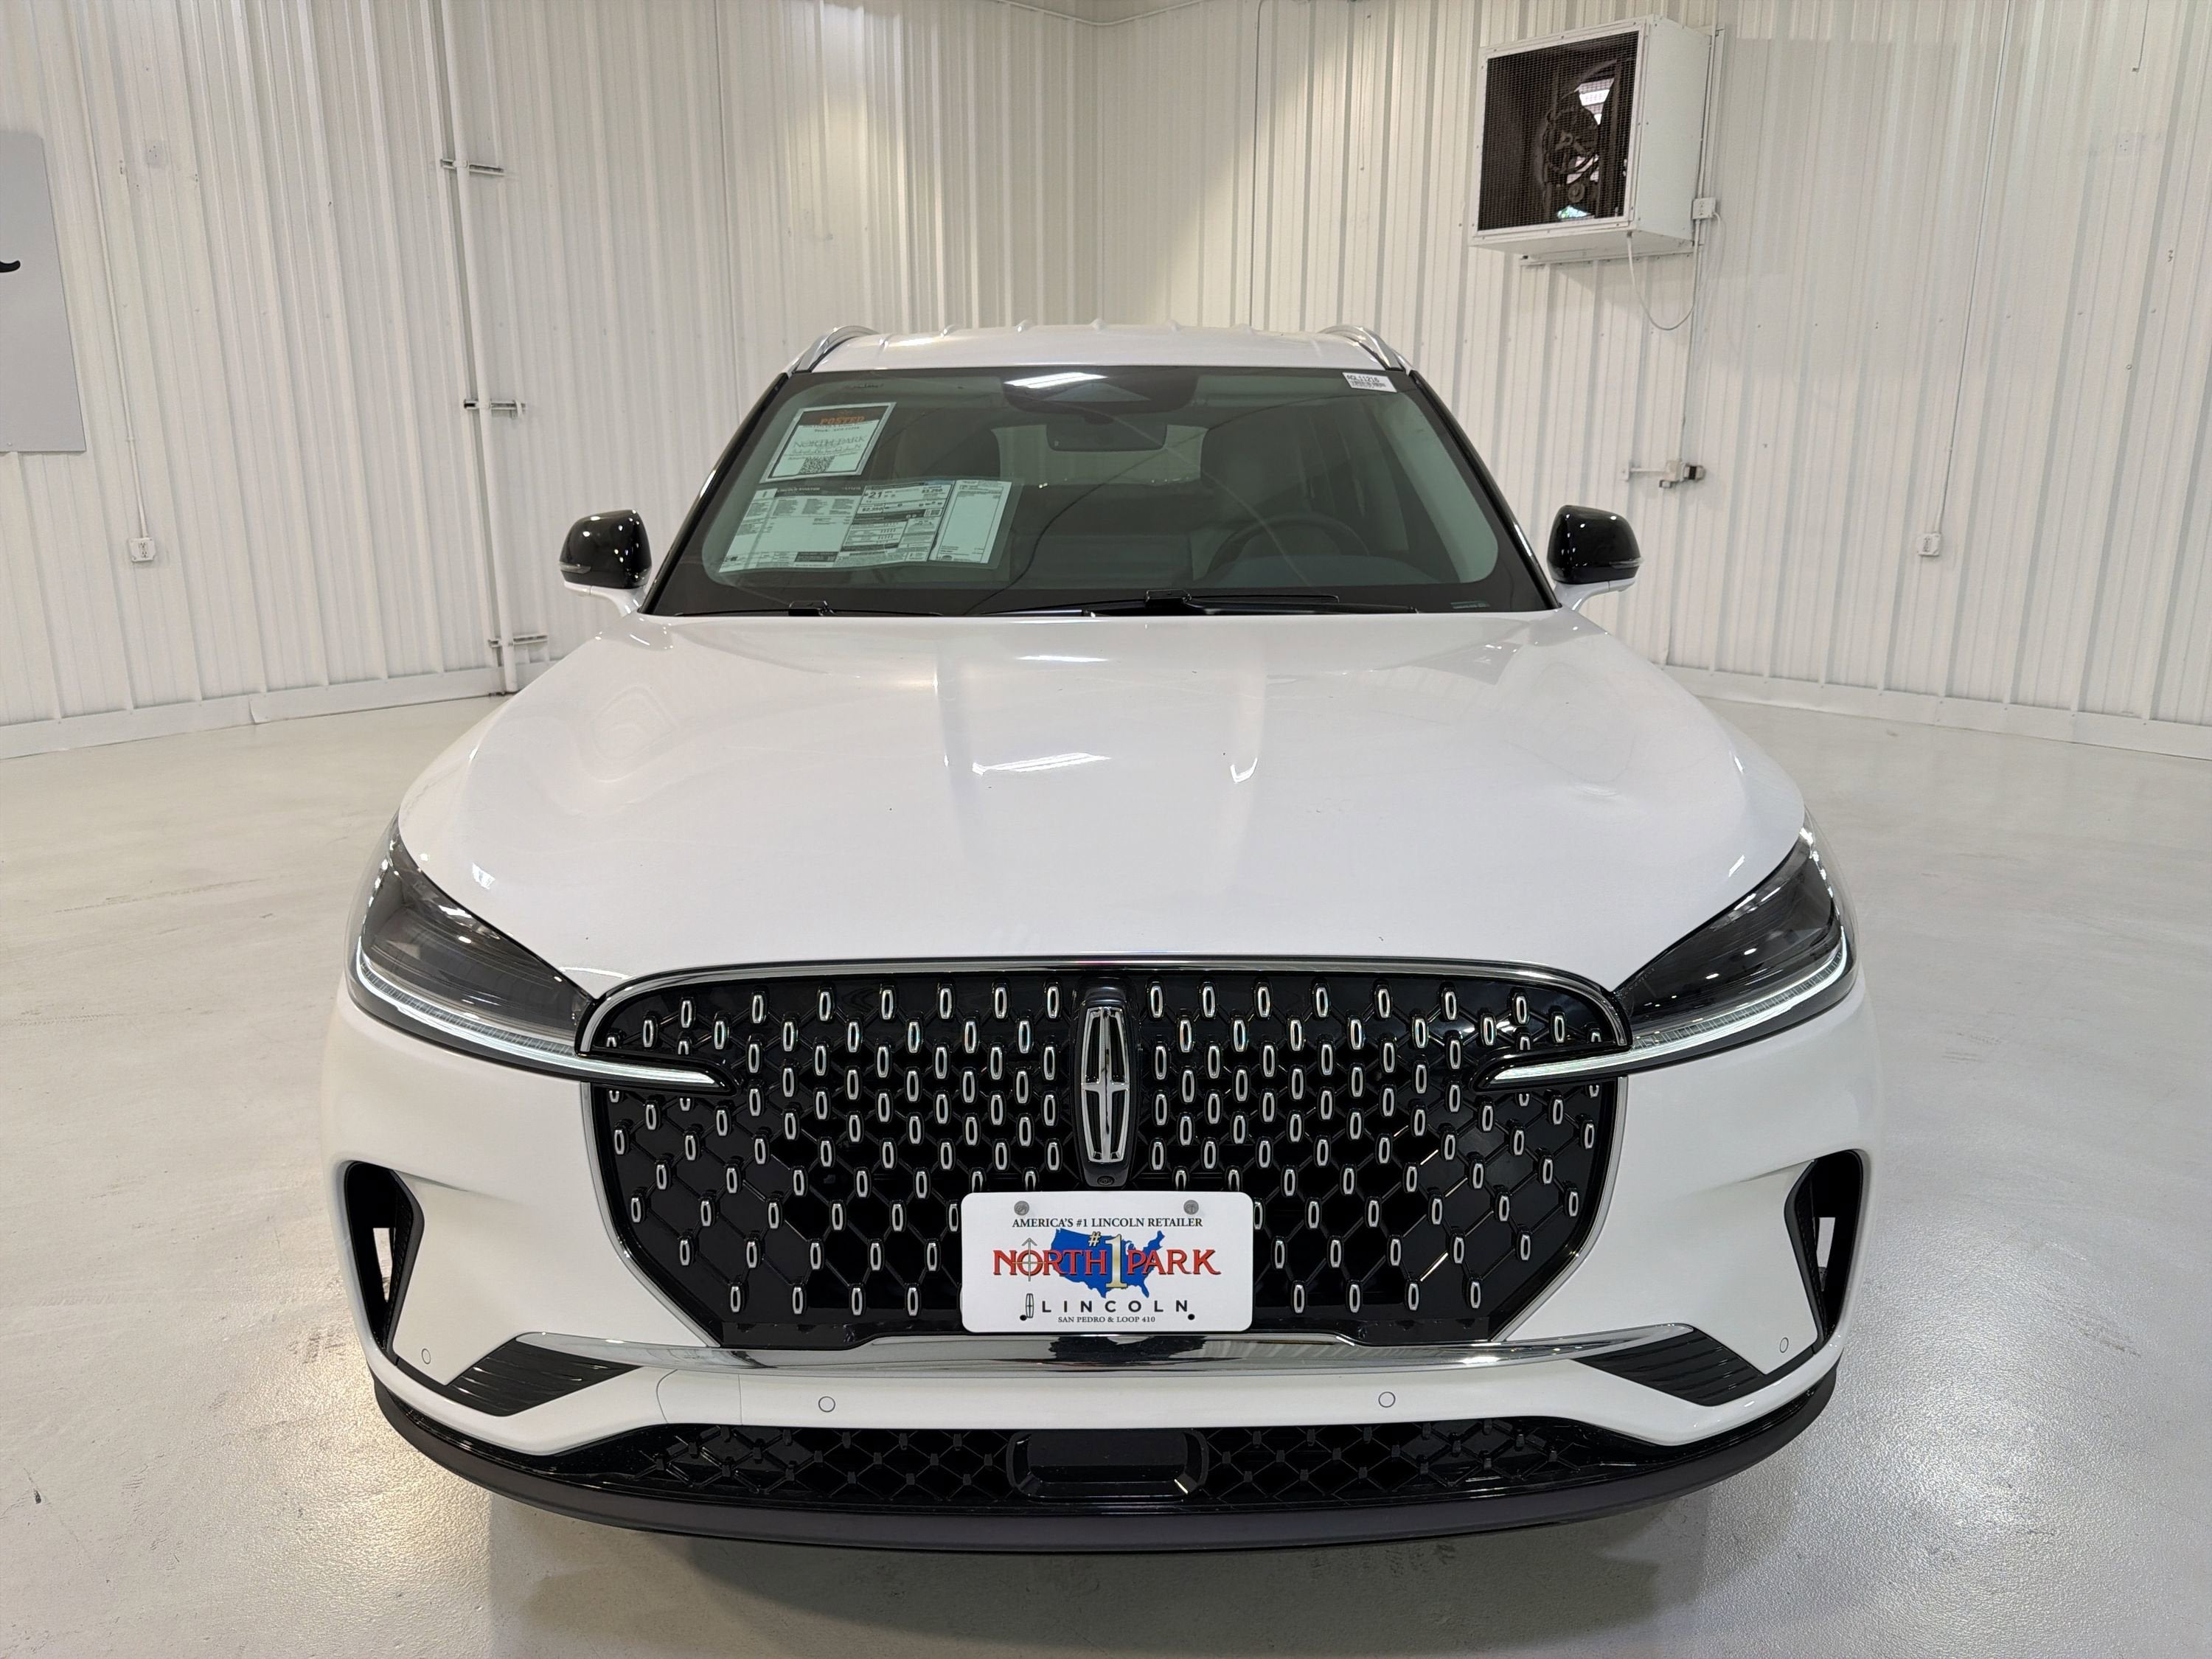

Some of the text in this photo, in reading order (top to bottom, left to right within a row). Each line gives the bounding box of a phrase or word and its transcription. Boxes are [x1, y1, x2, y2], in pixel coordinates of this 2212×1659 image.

[820, 416, 865, 425] POSTED
[1012, 1217, 1203, 1228] AMERICA'S #1 LINCOLN RETAILER
[993, 1249, 1221, 1276] NORTH PARK
[1042, 1300, 1188, 1312] LINCOLN
